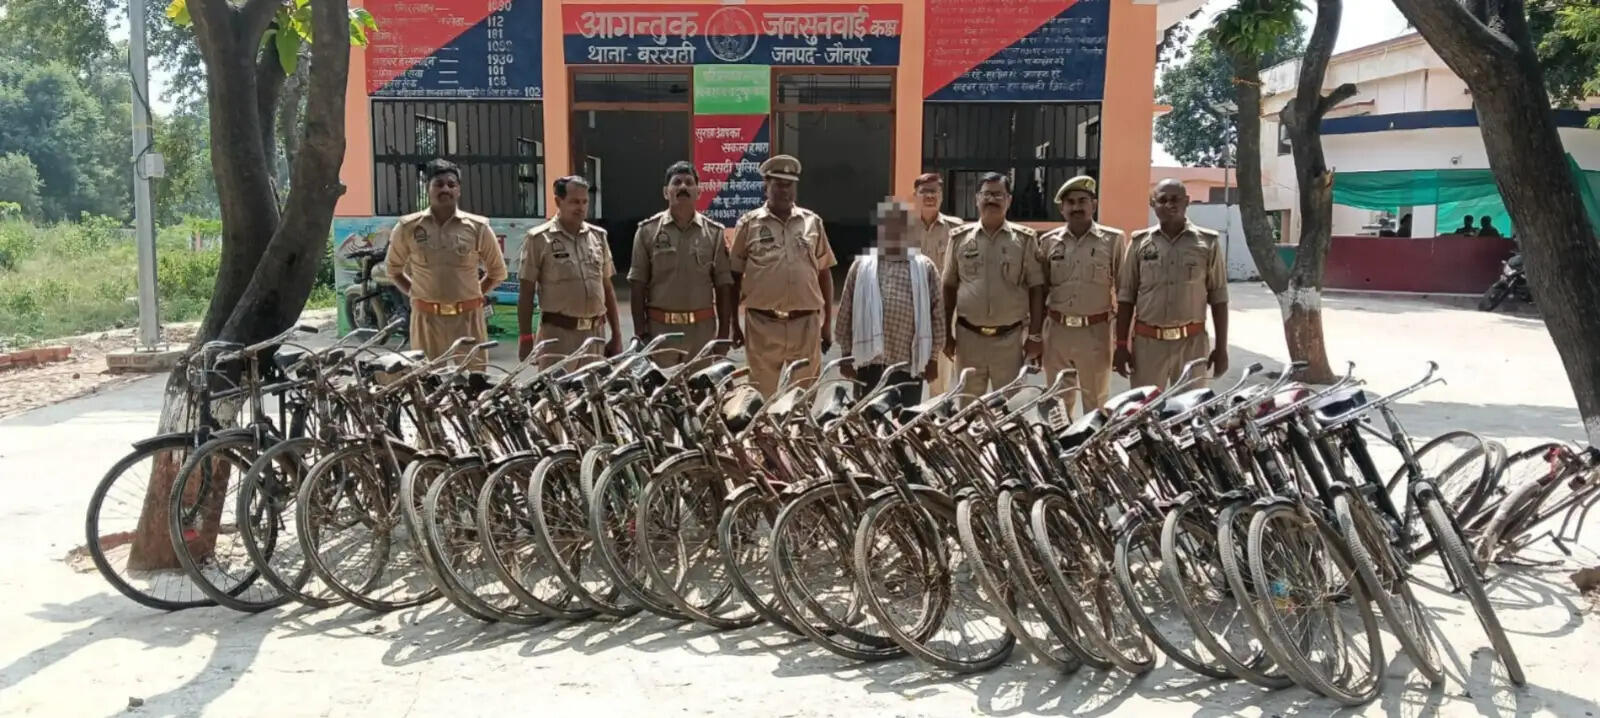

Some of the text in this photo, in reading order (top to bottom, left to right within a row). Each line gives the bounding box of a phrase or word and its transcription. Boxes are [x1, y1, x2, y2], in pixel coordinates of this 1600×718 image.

[488, 15, 504, 28] 112
[576, 5, 899, 45] आगन्तुक जनसुनवाई कक्ष
[487, 28, 503, 39] 181
[637, 40, 696, 64] बरसठी
[824, 41, 872, 66] जौनपुर
[488, 65, 504, 76] 101
[525, 86, 541, 97] 102
